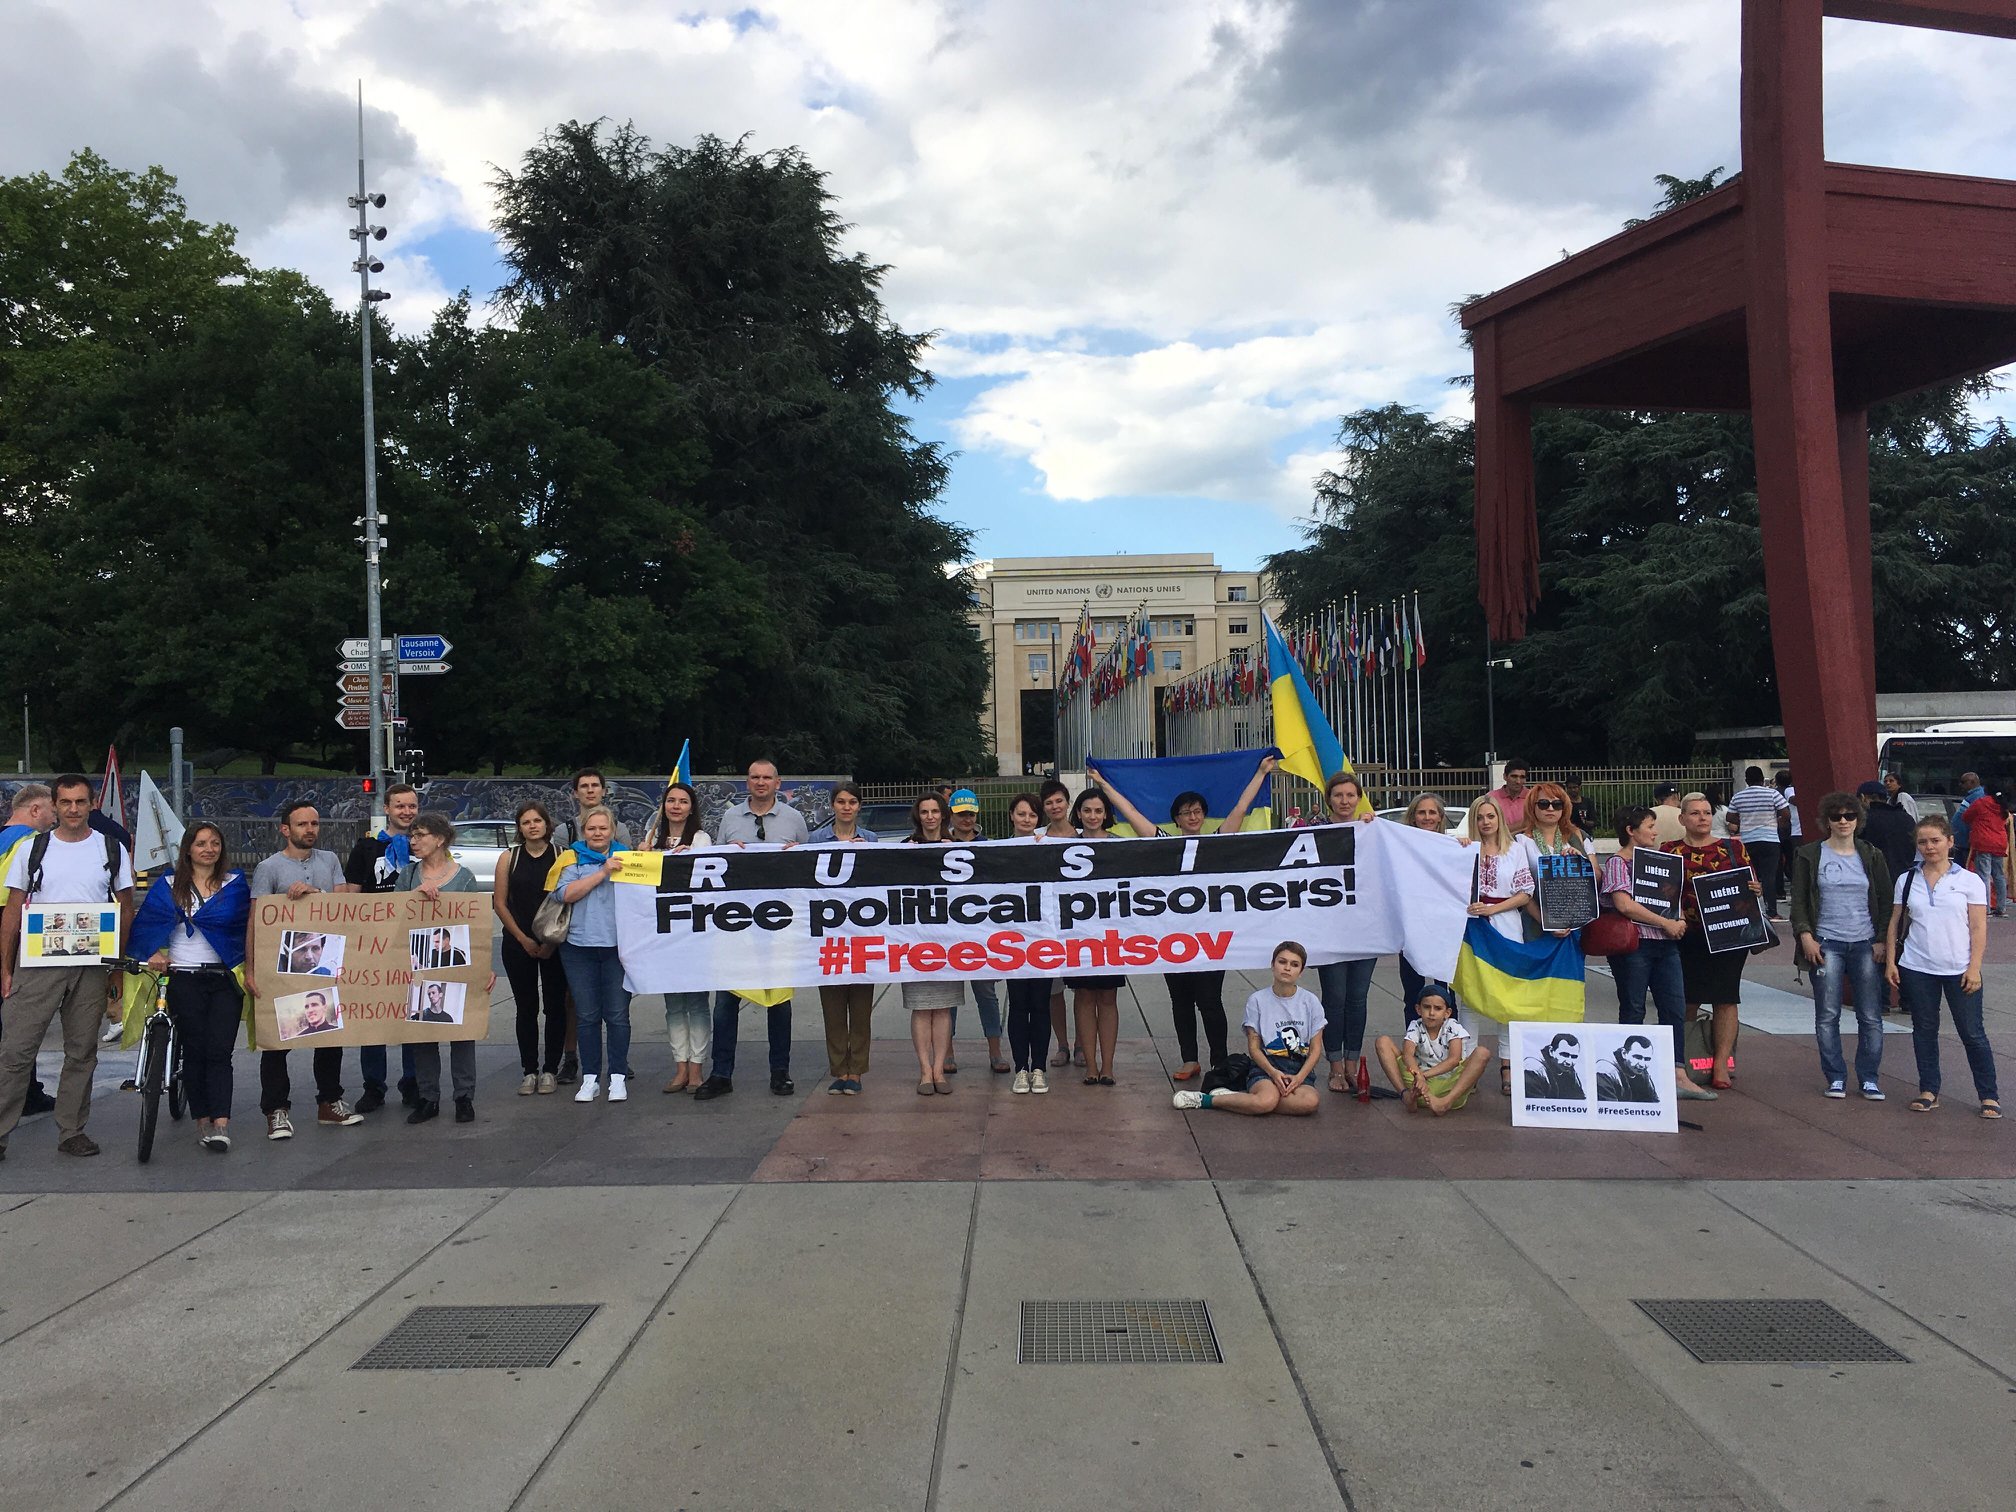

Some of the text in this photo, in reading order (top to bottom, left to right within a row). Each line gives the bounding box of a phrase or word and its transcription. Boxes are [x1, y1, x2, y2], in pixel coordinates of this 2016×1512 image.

[1026, 587, 1090, 596] UNITED NATIONS
[1117, 585, 1181, 594] NATIONS UNIES
[400, 639, 439, 648] Lausanne
[405, 649, 435, 657] Versoix
[1538, 855, 1595, 879] FREE
[1644, 865, 1670, 878] LIBÉREZ
[1710, 885, 1741, 899] LIBÉREZ
[656, 868, 1356, 937] Free political prisoners!
[1634, 895, 1671, 908] KOLTCHENKO
[262, 899, 480, 926] ON HUNGER STRIKE
[1707, 917, 1750, 932] KOLTCHENKO
[358, 935, 389, 955] IN
[819, 929, 1234, 975] #FreeSentsov
[335, 967, 414, 986] RUSSIAN
[335, 1002, 408, 1020] PRISONS
[1525, 1104, 1588, 1114] #FreeSentsov
[1598, 1107, 1662, 1117] #FreeSentsov
